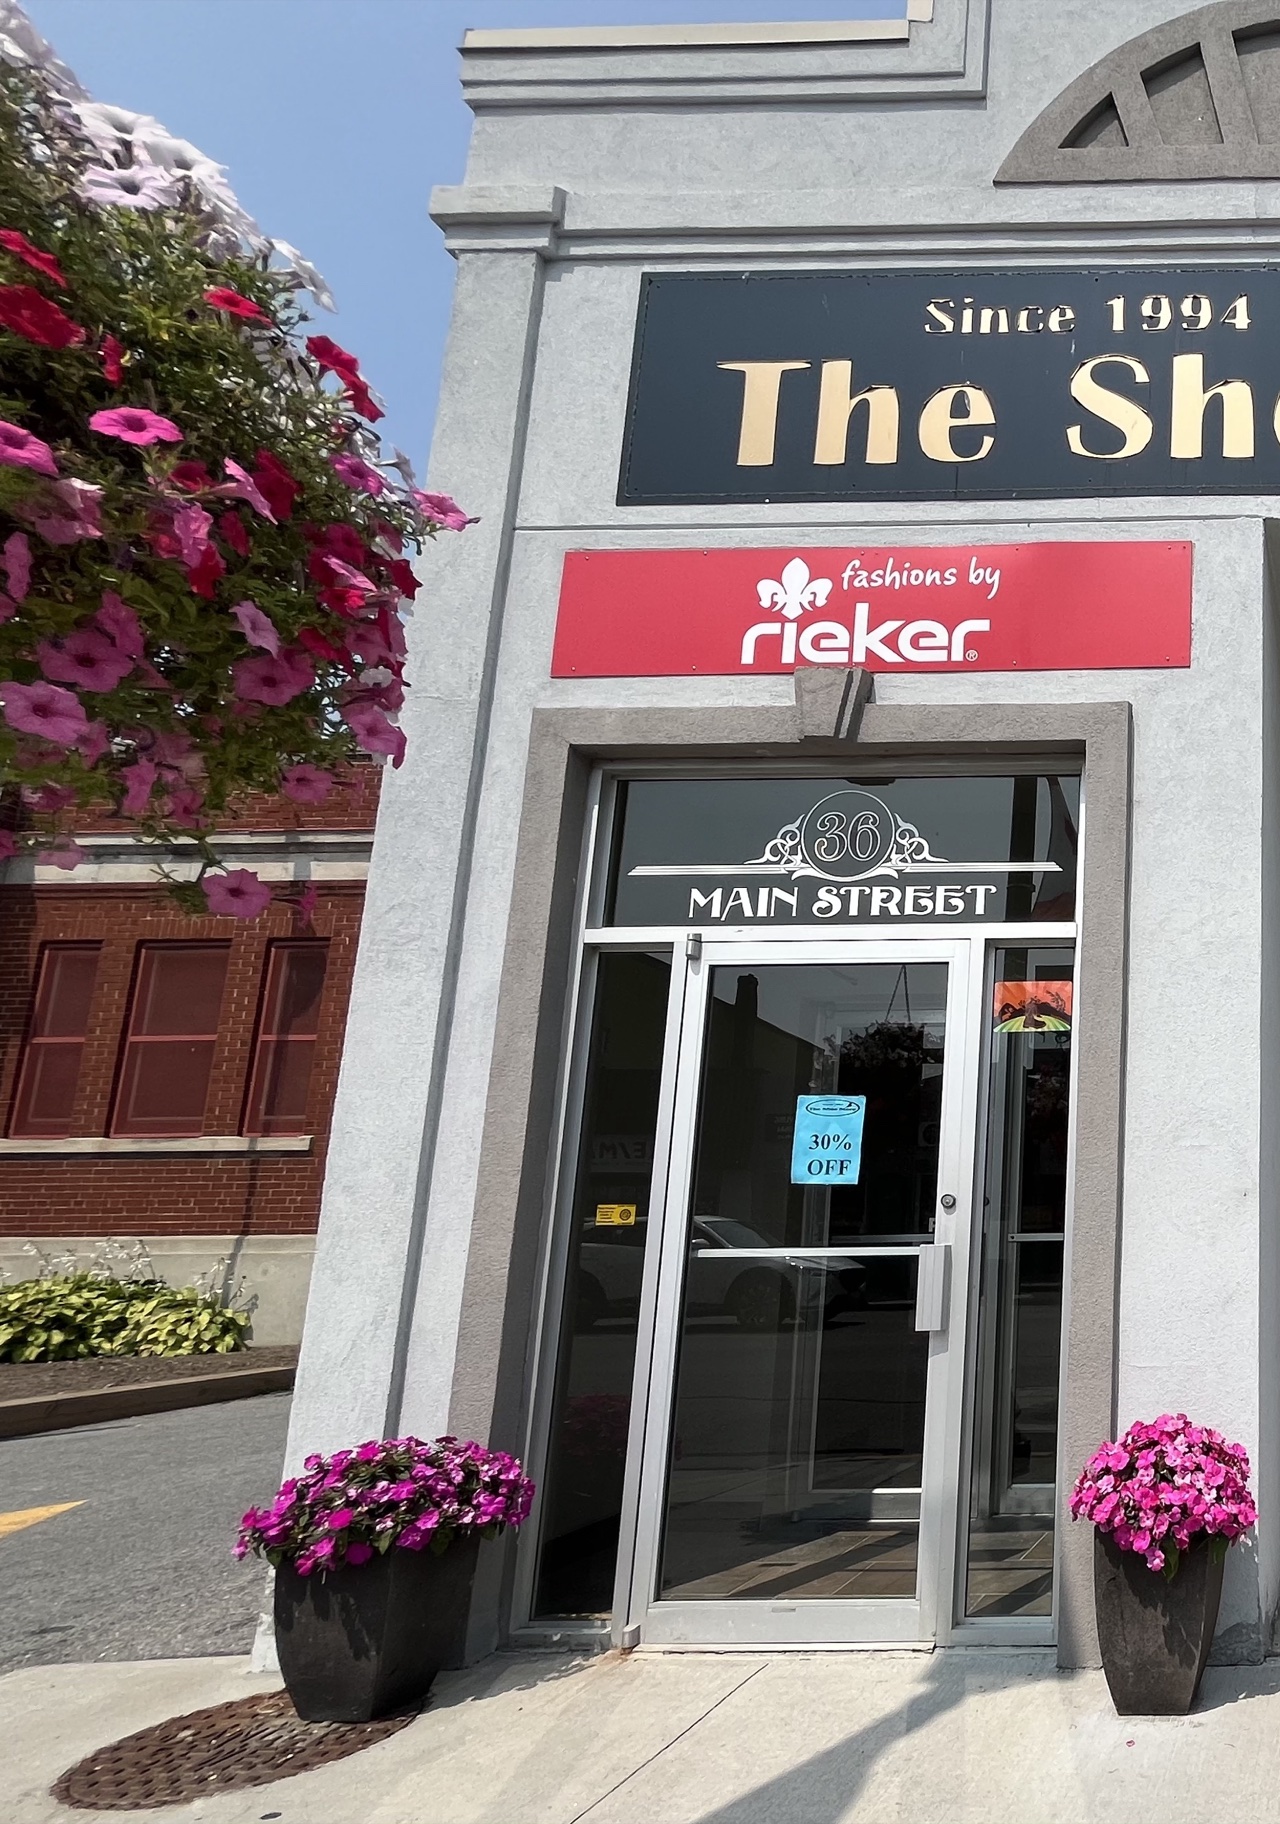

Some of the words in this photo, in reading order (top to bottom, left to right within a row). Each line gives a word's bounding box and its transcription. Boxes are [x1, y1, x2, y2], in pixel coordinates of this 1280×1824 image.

[924, 296, 1076, 334] Since
[1105, 293, 1253, 333] 1994
[716, 356, 997, 467] The
[841, 558, 957, 590] fashions
[968, 556, 1001, 599] by
[815, 811, 881, 862] 36
[688, 886, 799, 921] MAIN
[811, 884, 998, 918] STREET
[808, 1133, 852, 1151] 30%
[807, 1159, 852, 1176] OFF
